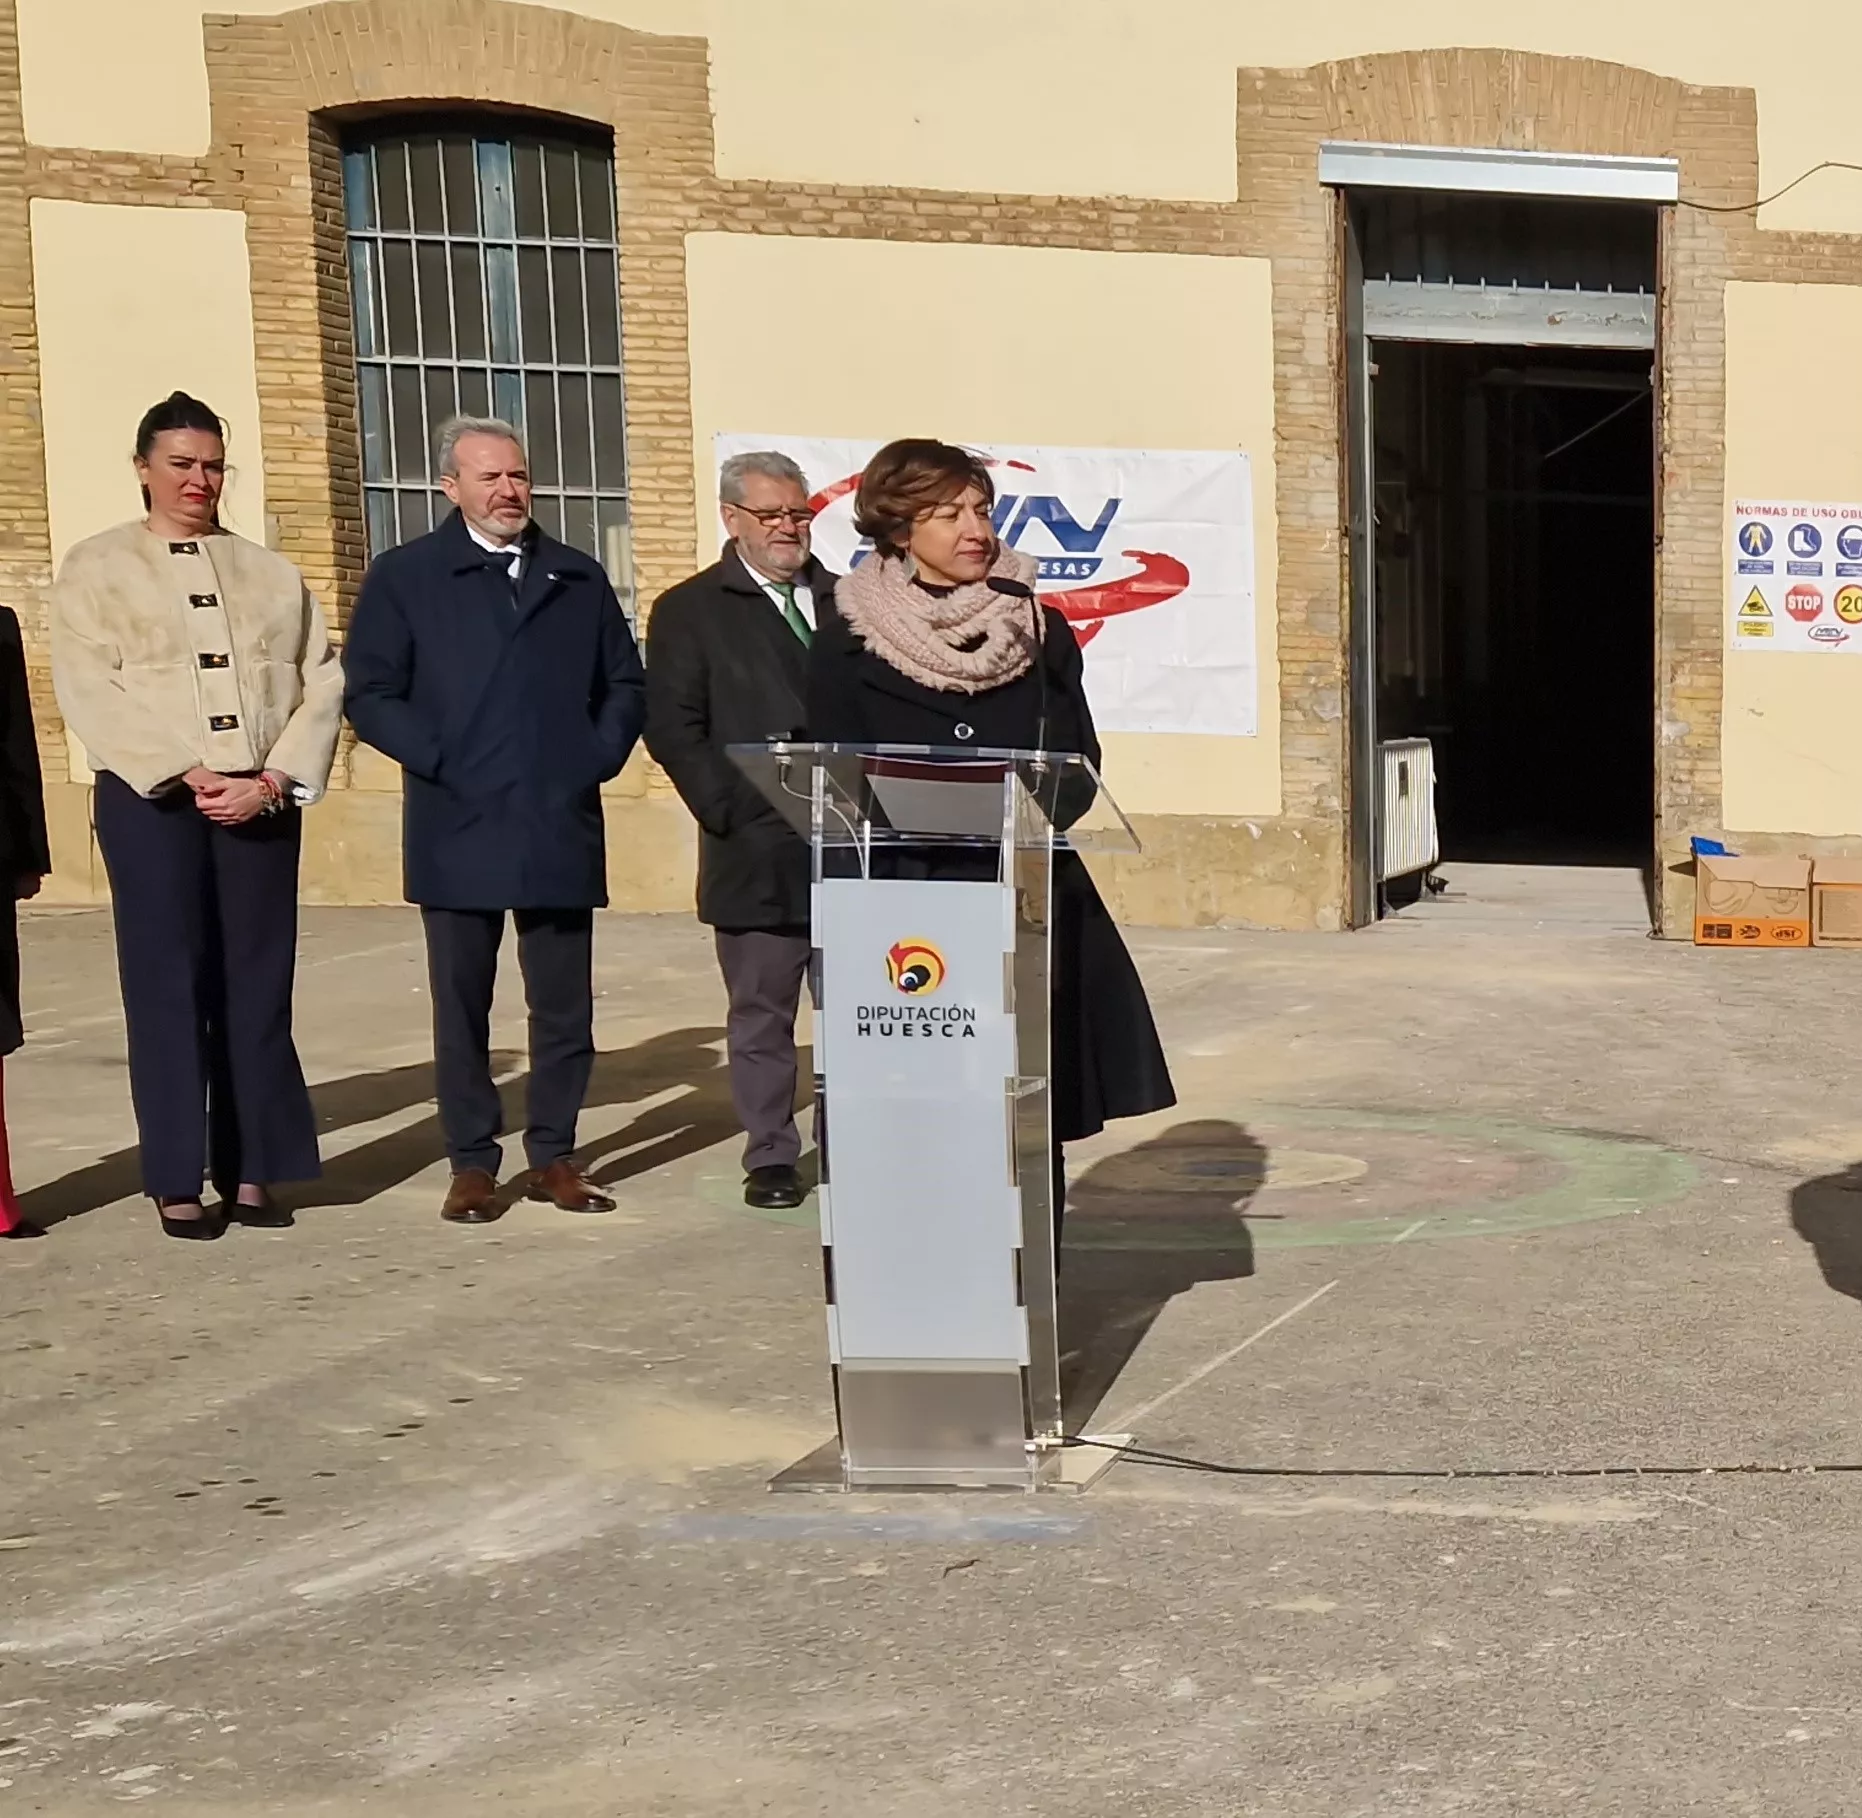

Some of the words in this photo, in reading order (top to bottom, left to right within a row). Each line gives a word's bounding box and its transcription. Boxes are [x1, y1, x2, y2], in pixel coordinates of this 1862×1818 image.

[1736, 505, 1788, 517] NORMAS
[1792, 507, 1807, 517] DE
[1812, 508, 1837, 518] USO
[1038, 562, 1092, 577] ESAS
[1787, 594, 1821, 611] STOP
[857, 1004, 976, 1021] DIPUTACIÓN
[857, 1023, 976, 1037] HUESCA
